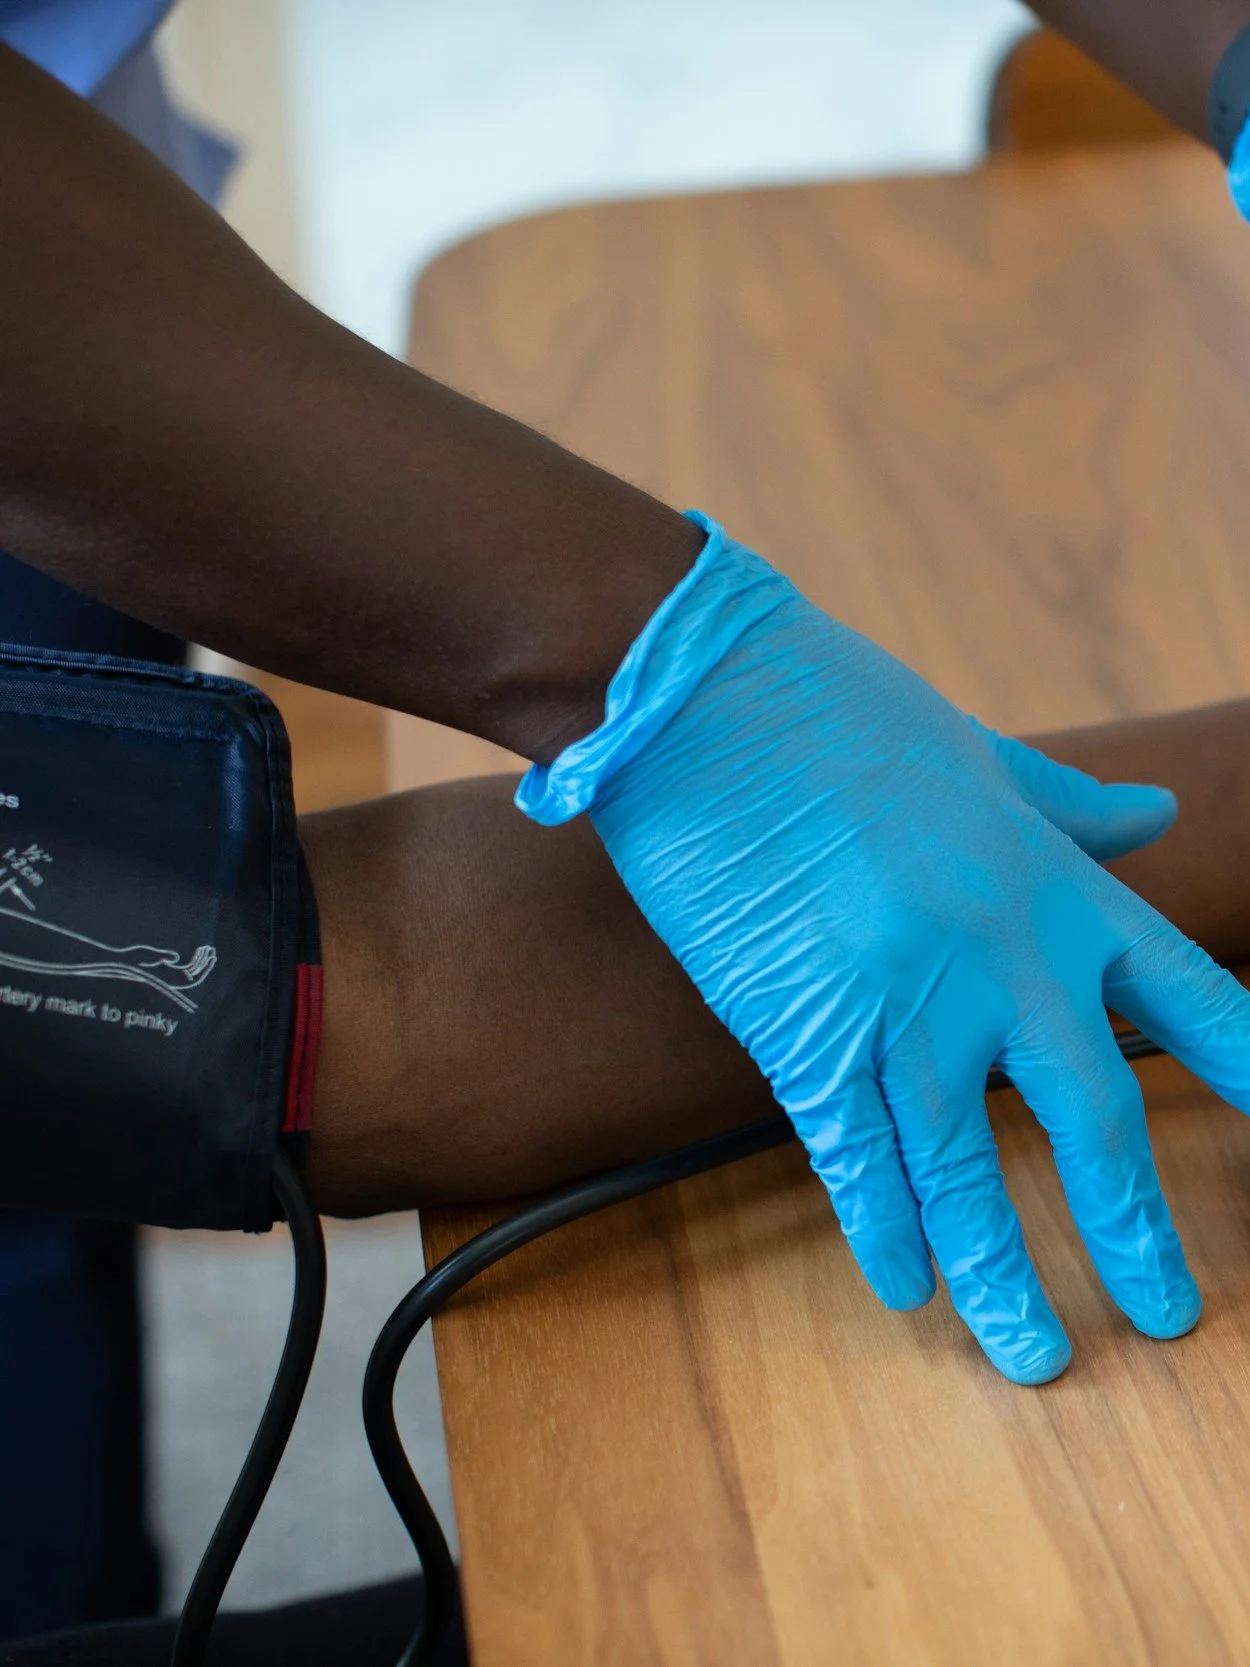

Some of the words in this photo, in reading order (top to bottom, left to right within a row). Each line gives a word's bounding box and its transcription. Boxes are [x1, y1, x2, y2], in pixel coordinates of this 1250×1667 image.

[45, 996, 97, 1018] mark
[101, 1003, 121, 1022] to
[124, 1009, 178, 1036] pinky
